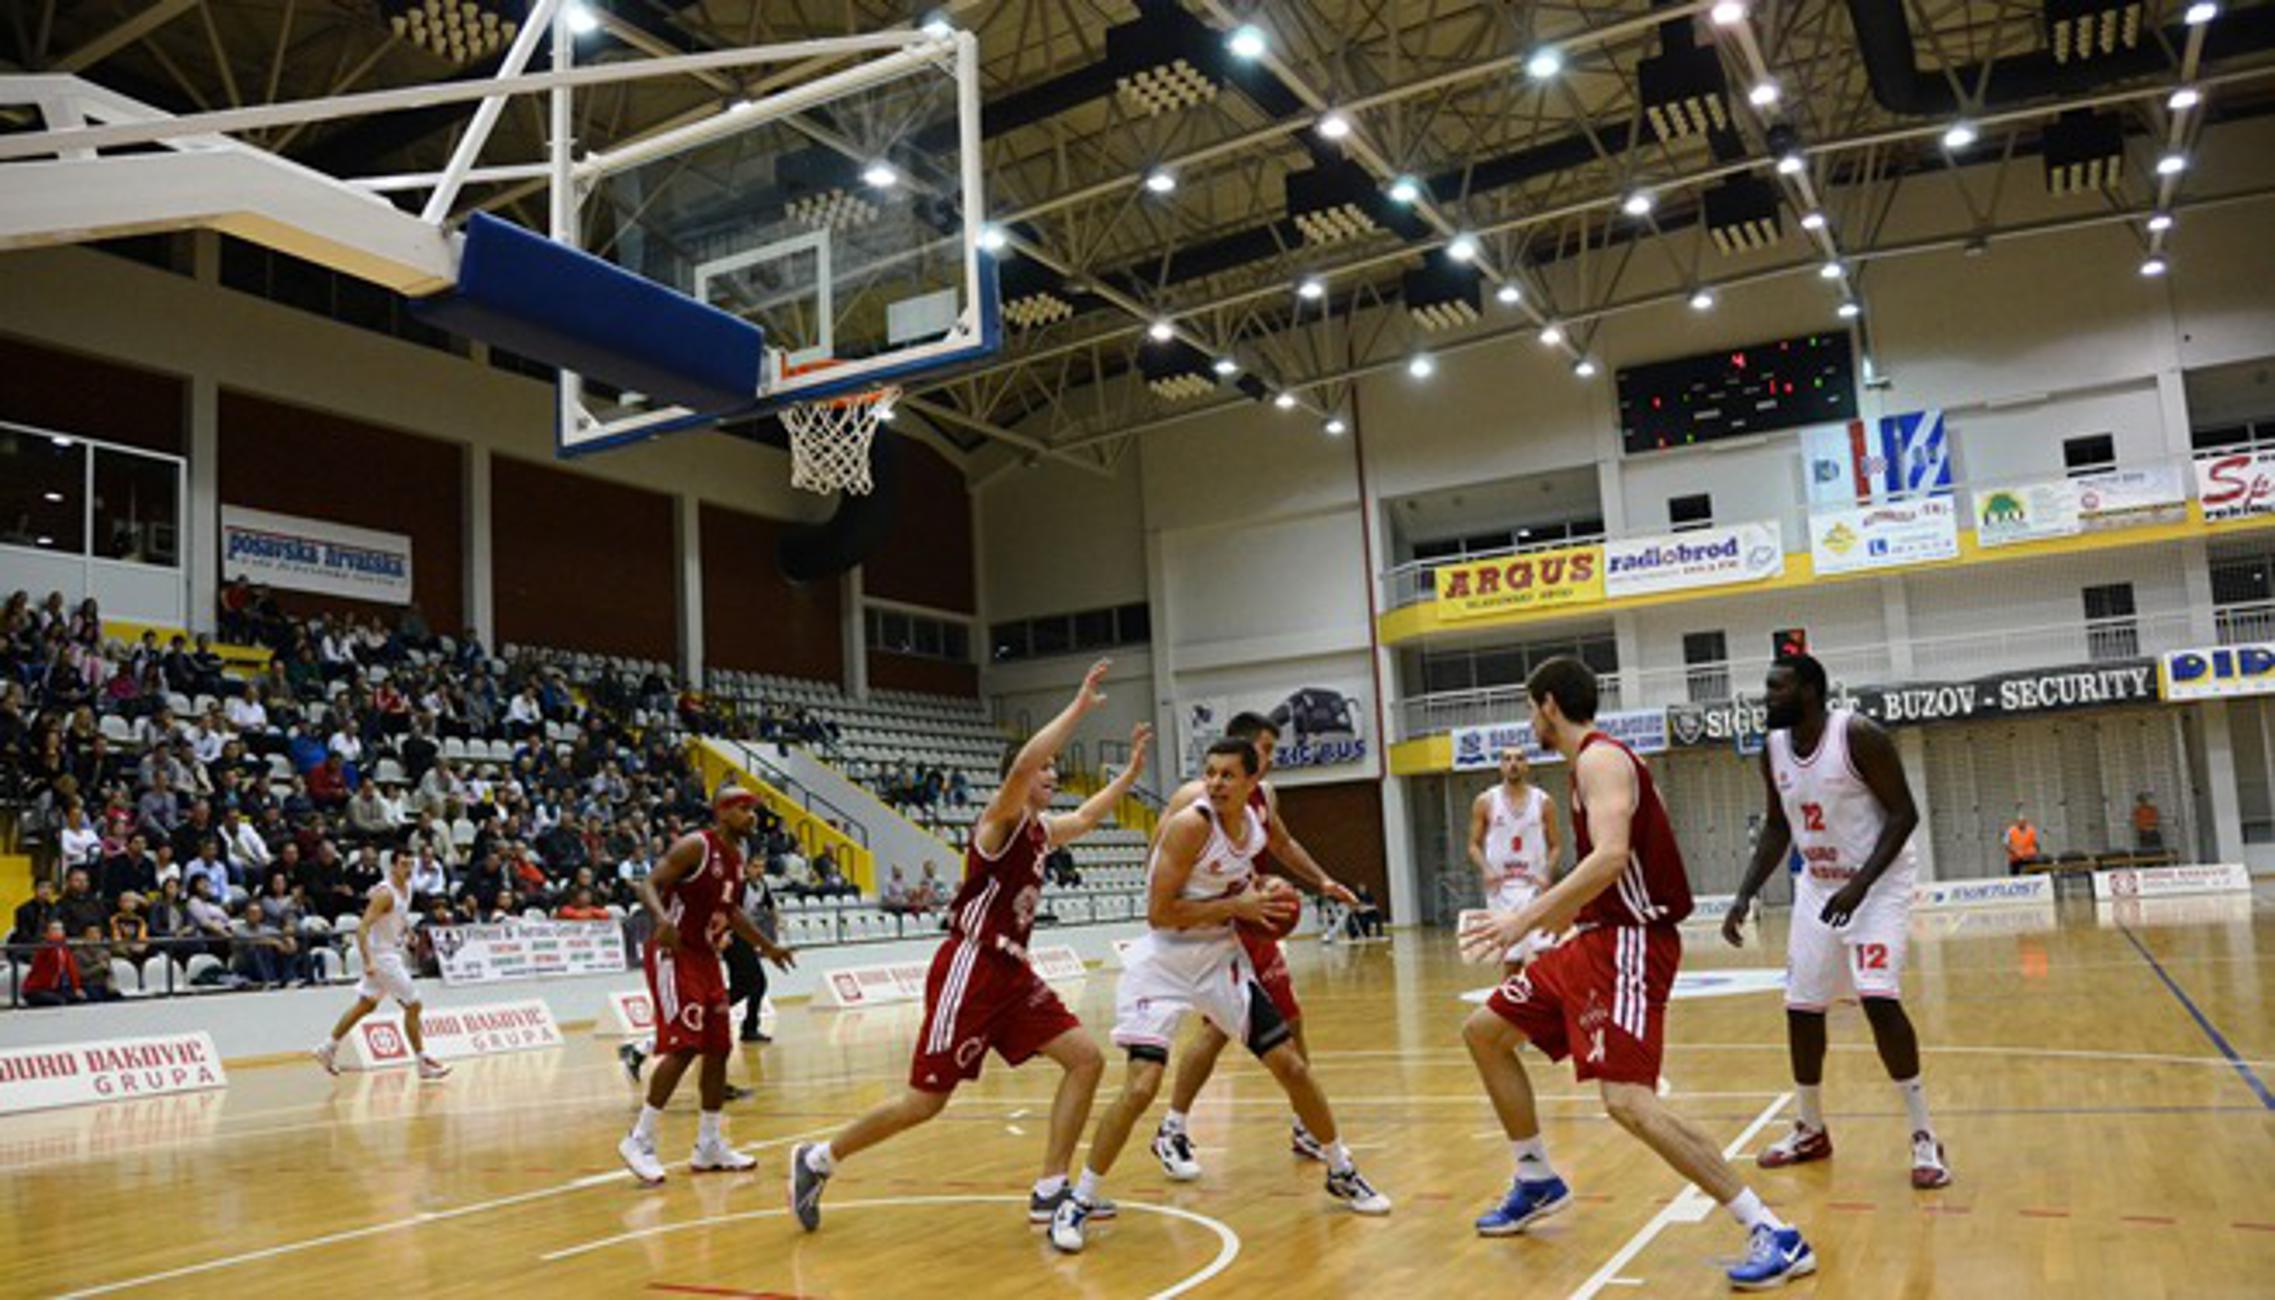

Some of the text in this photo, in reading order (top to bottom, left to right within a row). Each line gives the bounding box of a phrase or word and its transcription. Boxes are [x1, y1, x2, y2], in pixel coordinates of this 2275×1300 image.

[1608, 537, 1738, 574] radiobrod
[1445, 552, 1594, 599] ARGUS
[1883, 687, 1975, 720] BUZOV
[2000, 667, 2150, 710] SECURITY
[1801, 803, 1825, 831] 12
[1856, 943, 1888, 970] 12
[94, 1066, 215, 1095] GRUPA
